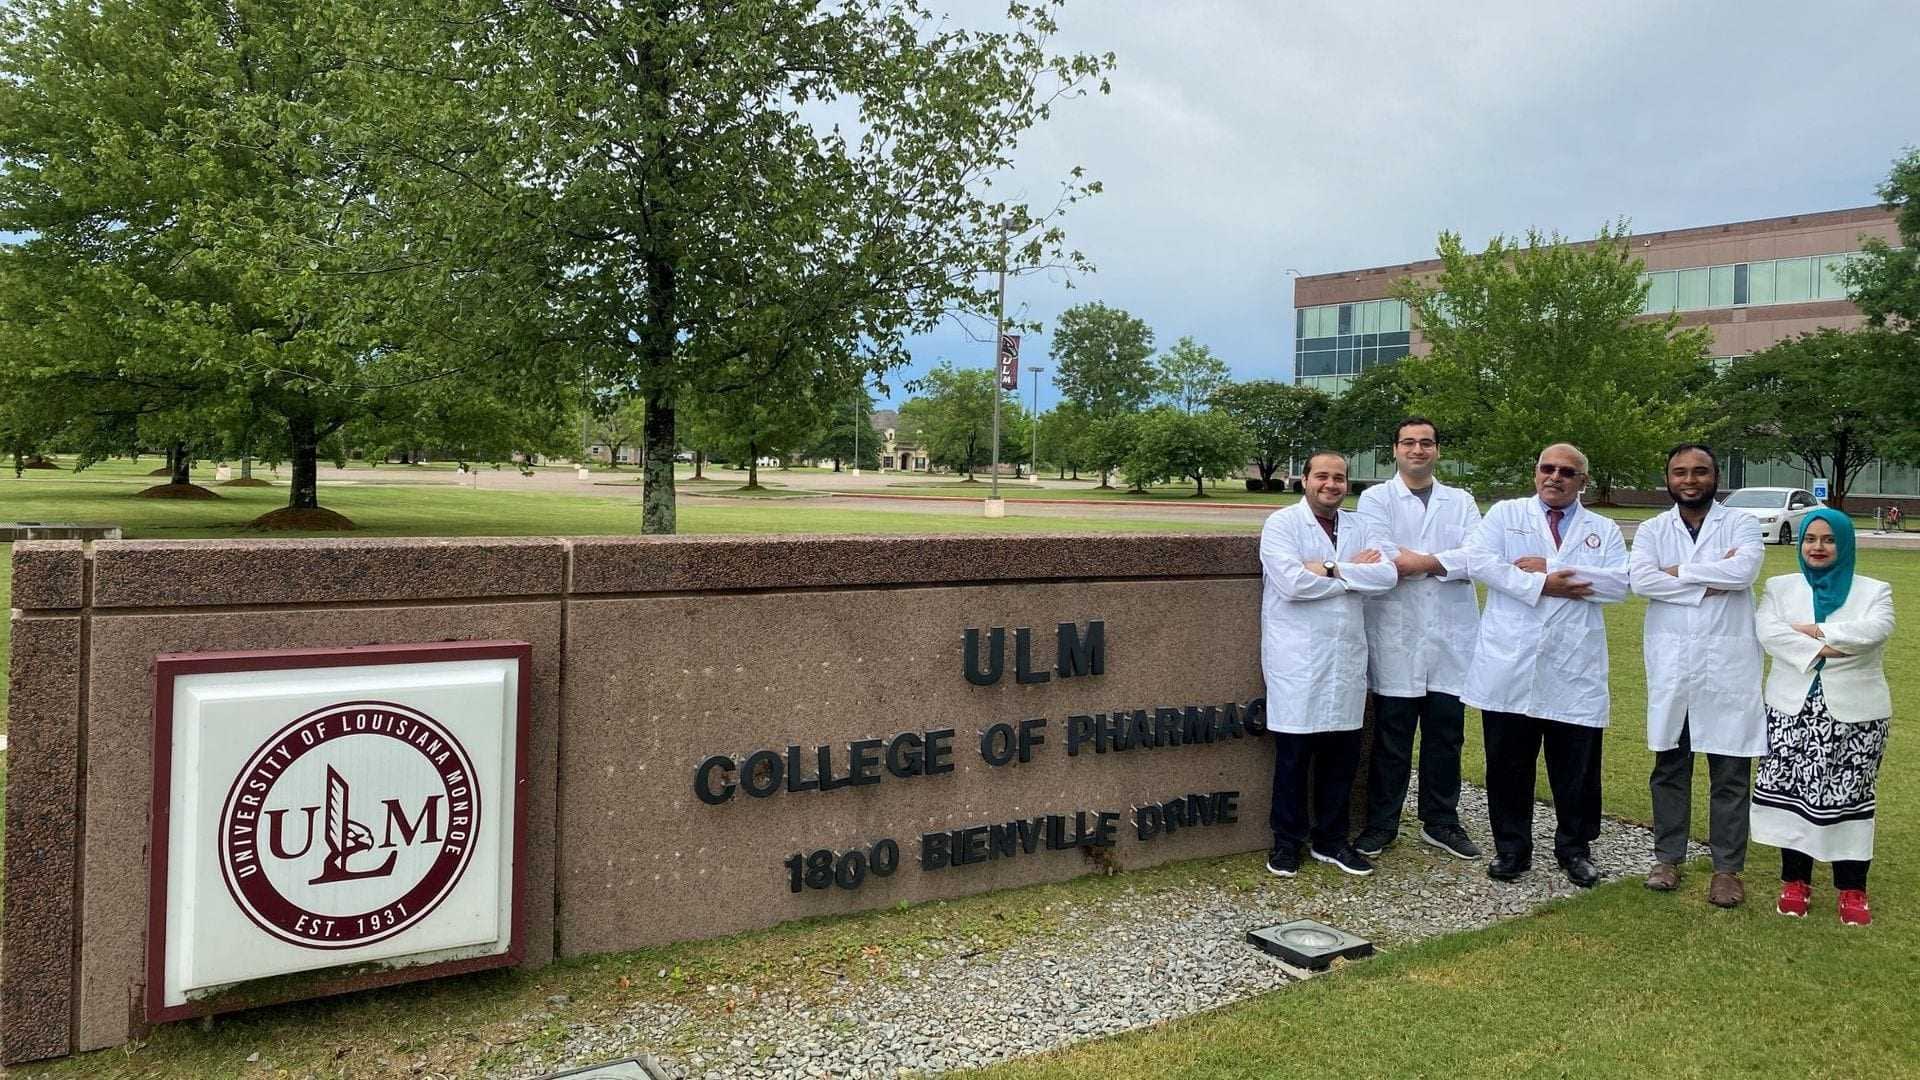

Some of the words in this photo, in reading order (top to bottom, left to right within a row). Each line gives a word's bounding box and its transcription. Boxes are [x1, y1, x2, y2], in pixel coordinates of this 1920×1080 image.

[961, 620, 1105, 686] ULM
[233, 746, 294, 878] UNIVERSITY
[301, 721, 326, 746] OF
[342, 713, 451, 766] LOUISIANA
[445, 769, 468, 855] MONROE
[695, 728, 955, 804] COLLEGE
[980, 718, 1047, 767] OF
[1066, 698, 1268, 757] PHARMAC
[264, 763, 445, 885] ULM
[786, 838, 899, 893] 1800
[921, 811, 1120, 871] BIENVILLE
[1136, 791, 1240, 841] DRIVE
[294, 914, 341, 937] EST.
[357, 903, 408, 934] 1931
